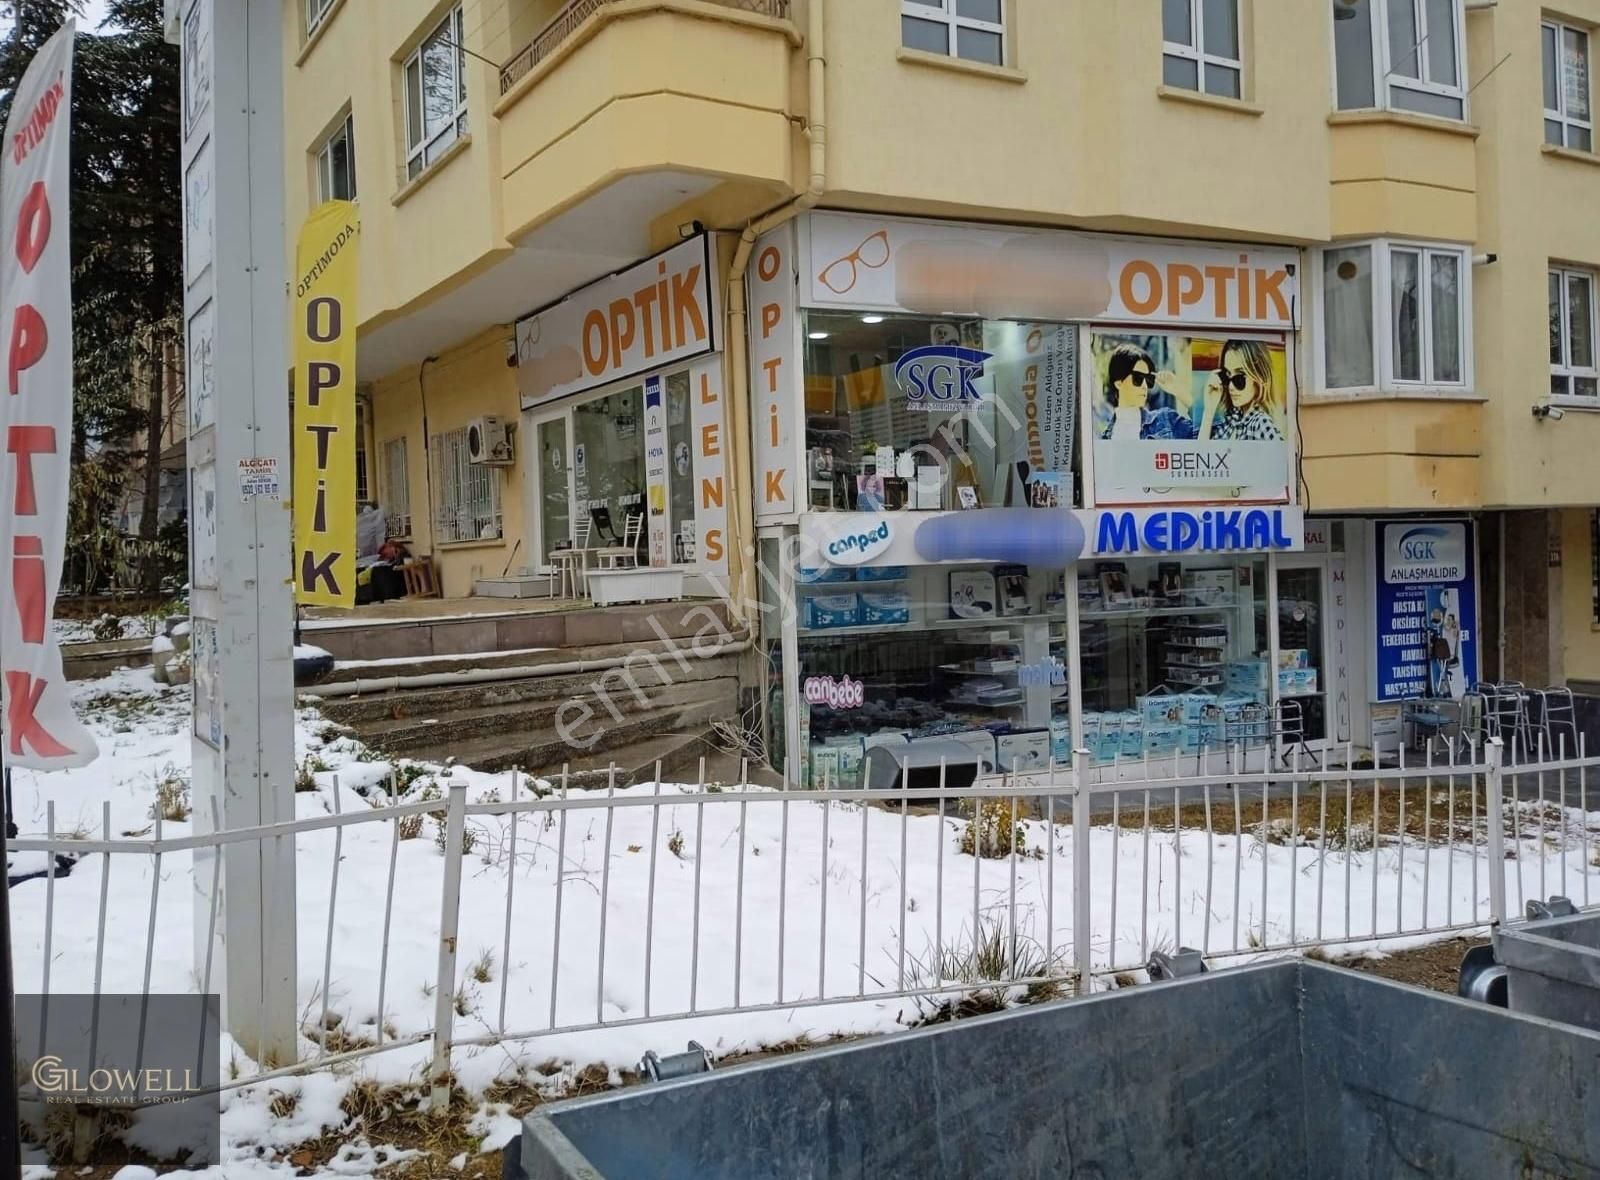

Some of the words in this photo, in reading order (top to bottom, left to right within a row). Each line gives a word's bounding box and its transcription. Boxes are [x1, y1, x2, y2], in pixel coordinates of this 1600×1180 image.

[1119, 253, 1290, 321] OPTİK
[582, 258, 706, 377] OPTİK
[758, 246, 785, 504] OPTİK
[907, 363, 984, 401] SGK
[1055, 358, 1064, 396] Ondan
[1054, 398, 1062, 414] Siz
[1063, 364, 1074, 432] Güvencemiz
[301, 297, 342, 596] OPTİK
[1062, 434, 1071, 465] Kadar
[1170, 452, 1229, 470] BEN.X
[701, 373, 723, 561] LENS
[828, 521, 889, 555] canped
[1303, 531, 1325, 544] KAL
[1404, 541, 1437, 561] SGK
[1391, 566, 1459, 581] ANLAŞMALIDIR
[1393, 601, 1416, 613] HASTA
[1381, 631, 1421, 647] TEKERLEKLİ
[805, 675, 863, 709] canbebe
